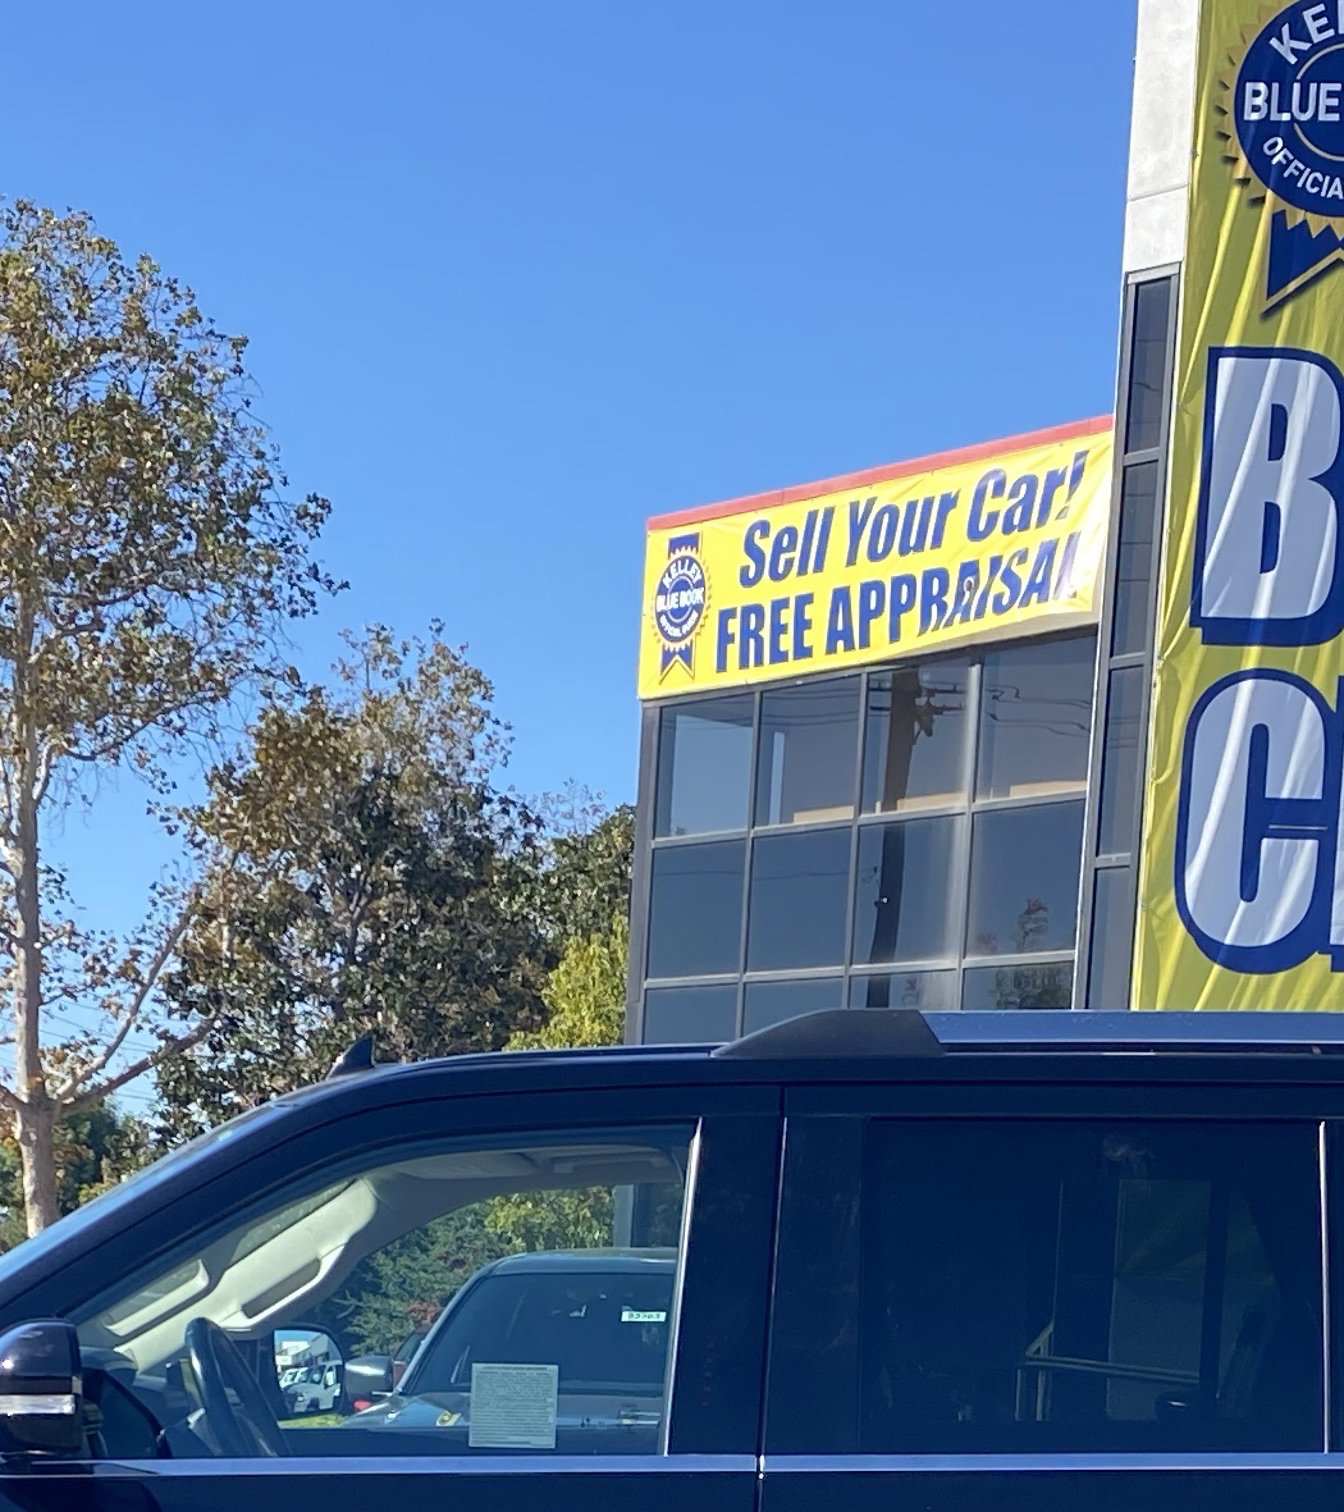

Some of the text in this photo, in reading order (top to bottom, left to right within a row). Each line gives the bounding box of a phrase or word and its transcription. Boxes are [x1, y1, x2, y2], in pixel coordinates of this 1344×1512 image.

[1243, 82, 1342, 121] BLUE
[739, 450, 1090, 588] Sell Your Car!
[715, 592, 815, 674] FREE
